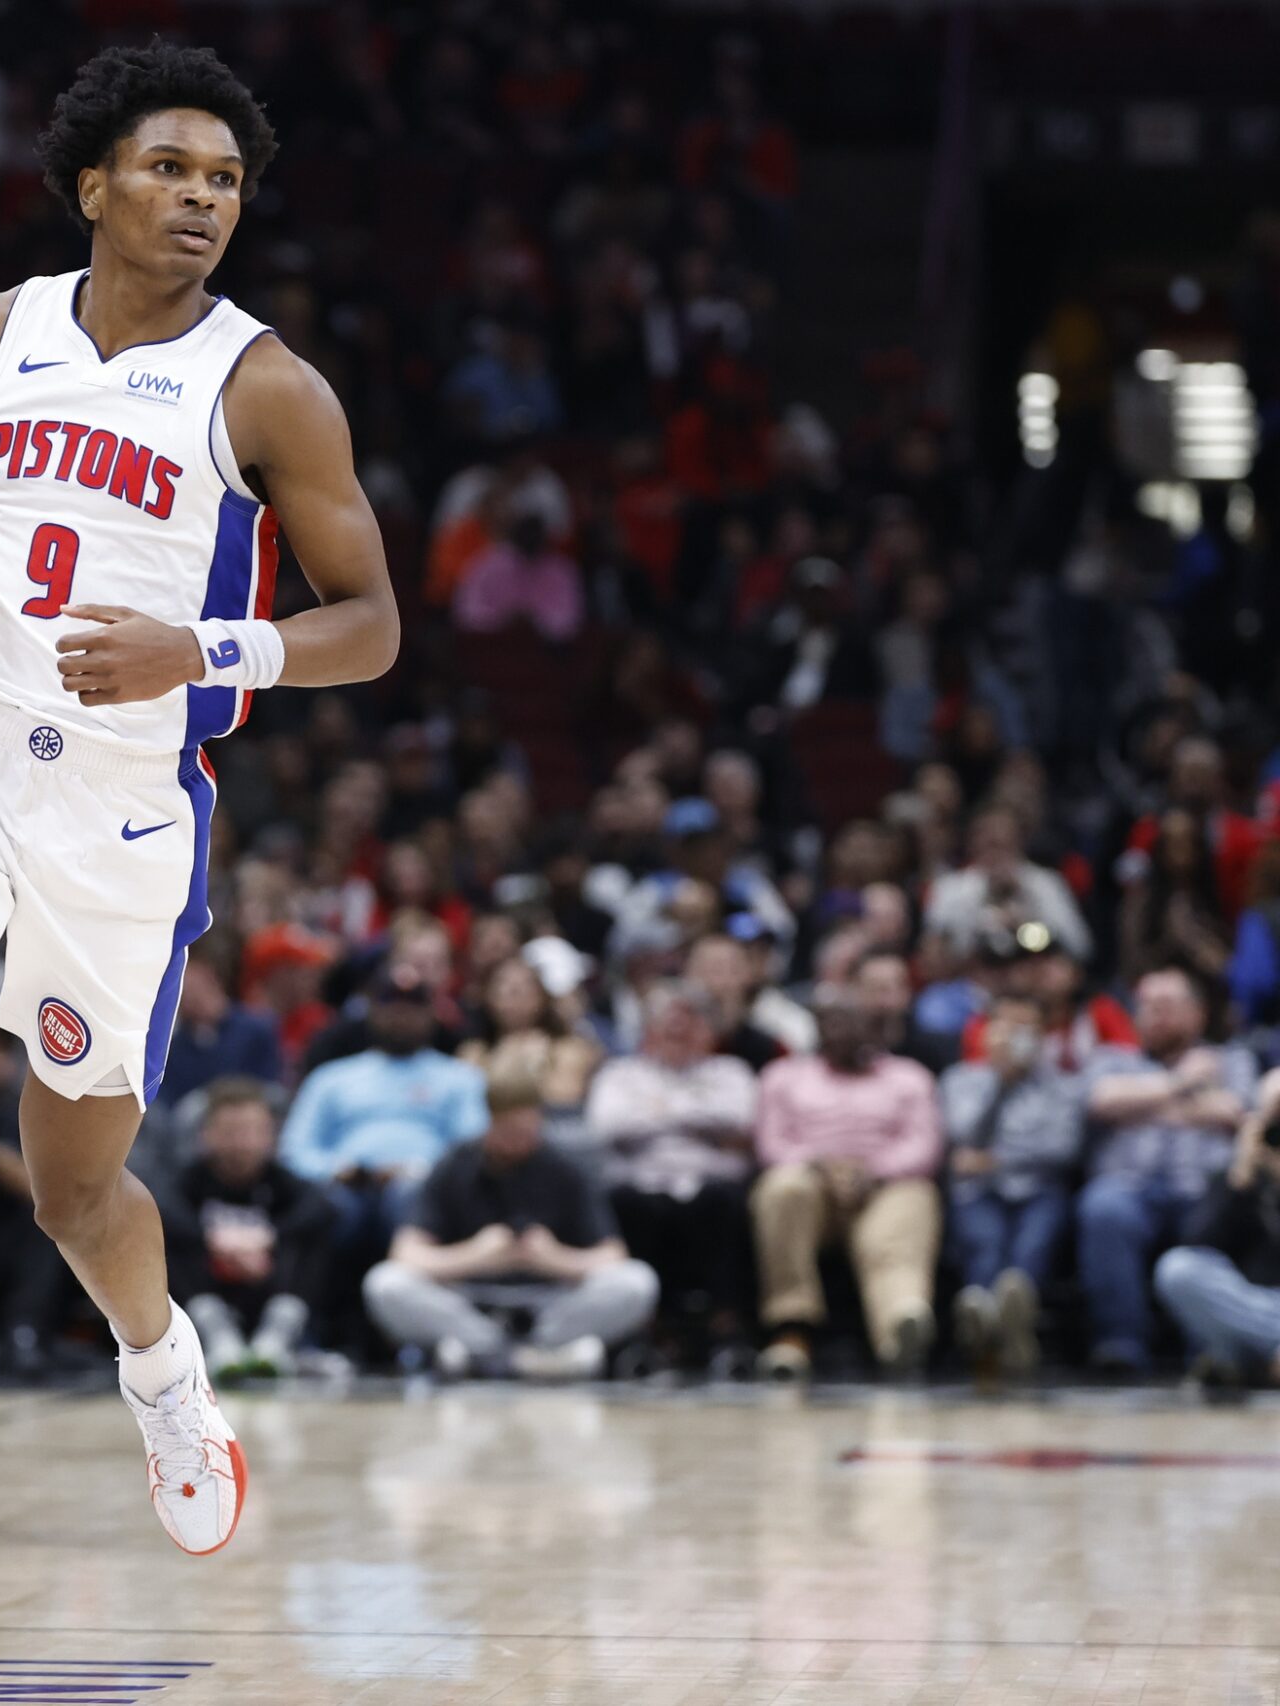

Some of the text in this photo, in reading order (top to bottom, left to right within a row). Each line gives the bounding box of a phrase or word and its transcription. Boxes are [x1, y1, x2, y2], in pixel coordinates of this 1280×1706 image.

[127, 370, 184, 399] UWM
[21, 523, 80, 619] 9
[207, 639, 241, 670] 9
[44, 1018, 75, 1053] PISTONS
[47, 1010, 79, 1044] DETROIT
